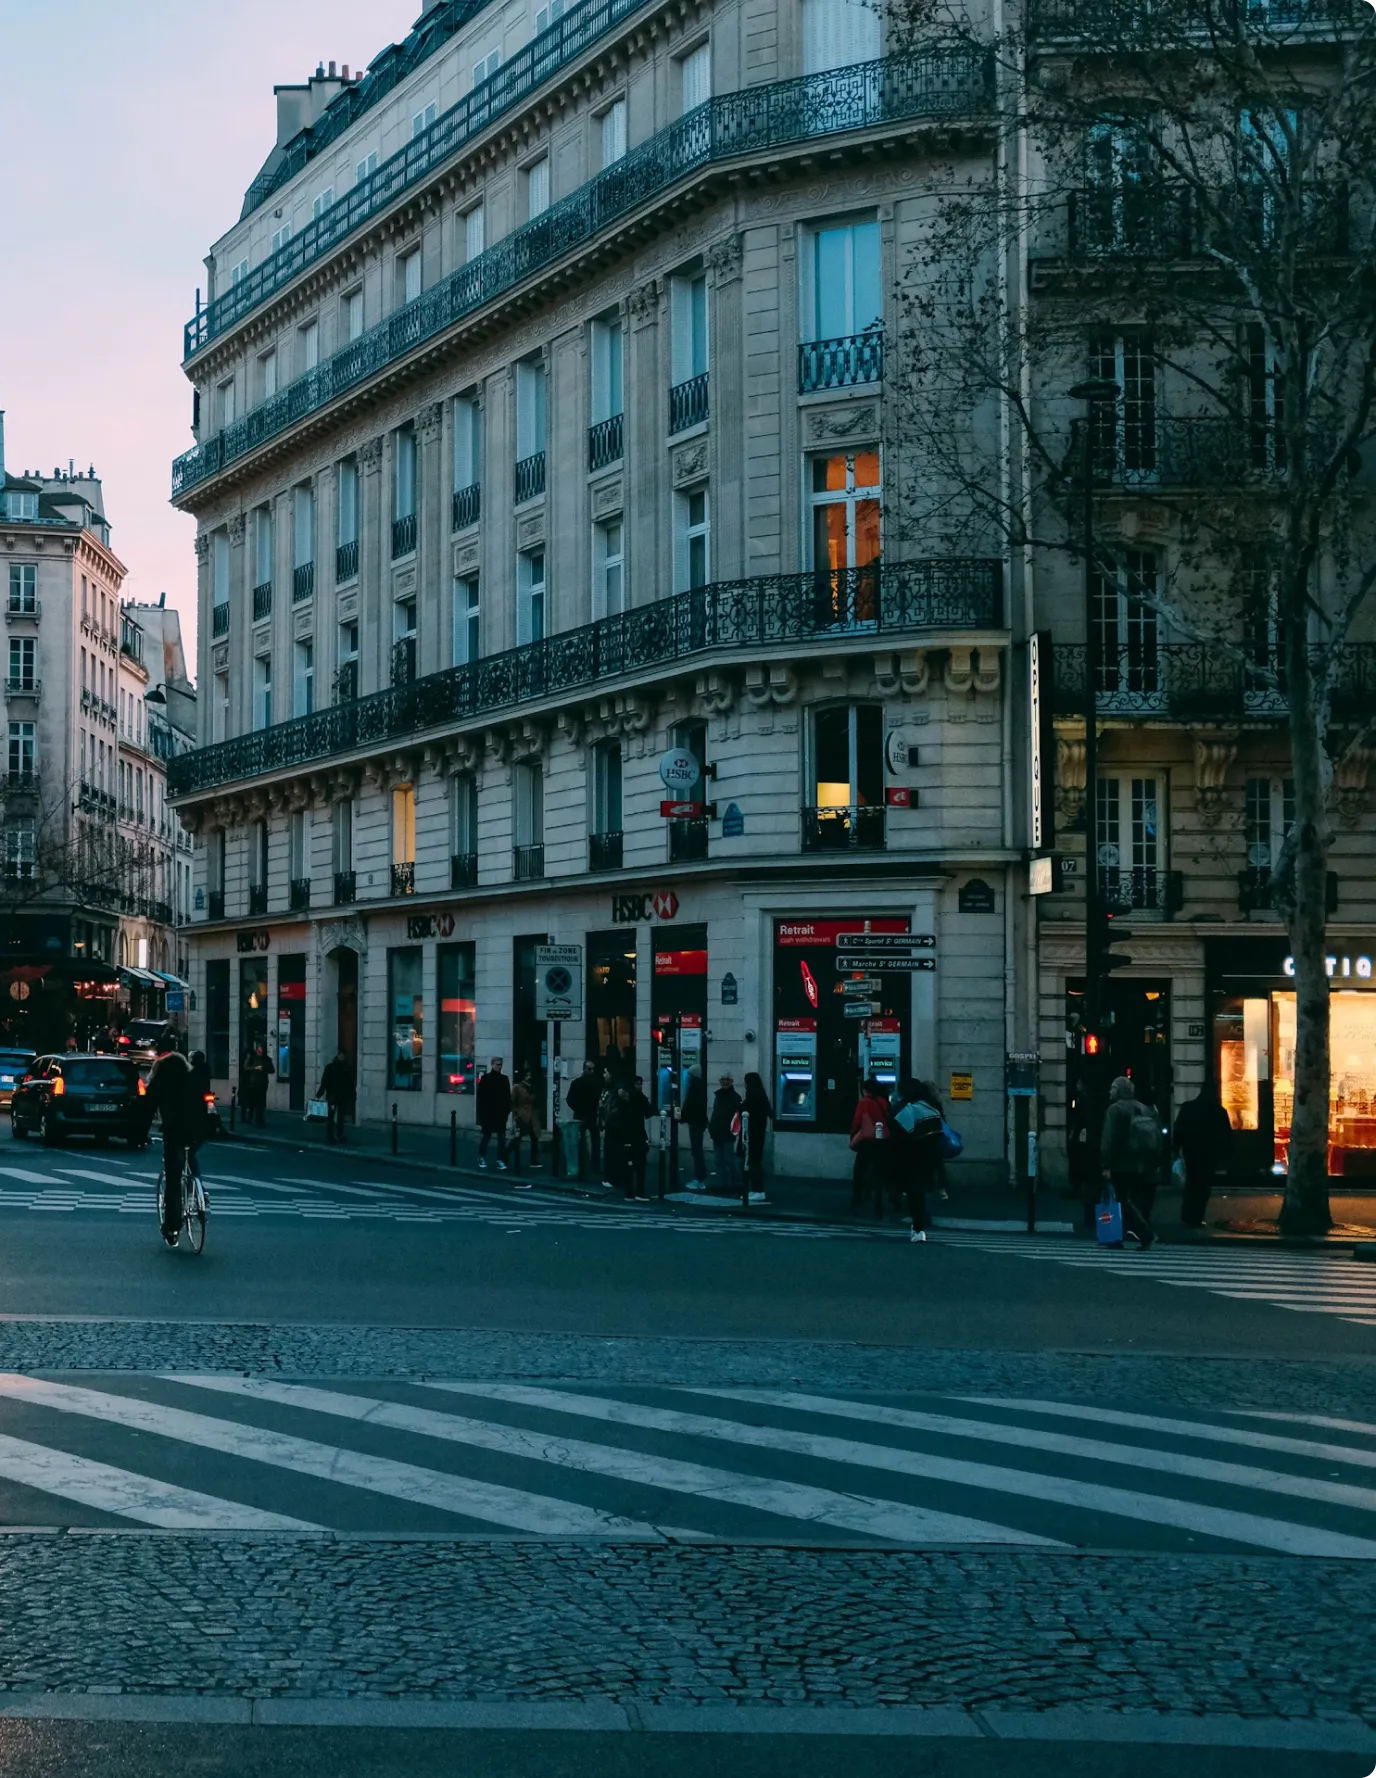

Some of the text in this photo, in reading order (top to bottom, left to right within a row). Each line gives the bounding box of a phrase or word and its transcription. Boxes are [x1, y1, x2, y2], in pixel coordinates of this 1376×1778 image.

[1031, 641, 1040, 842] OPTIQUE
[666, 768, 696, 780] HSBC
[1061, 861, 1075, 872] 07
[612, 894, 653, 923] HSBC
[407, 914, 437, 938] HSBC
[779, 925, 814, 935] Retrait
